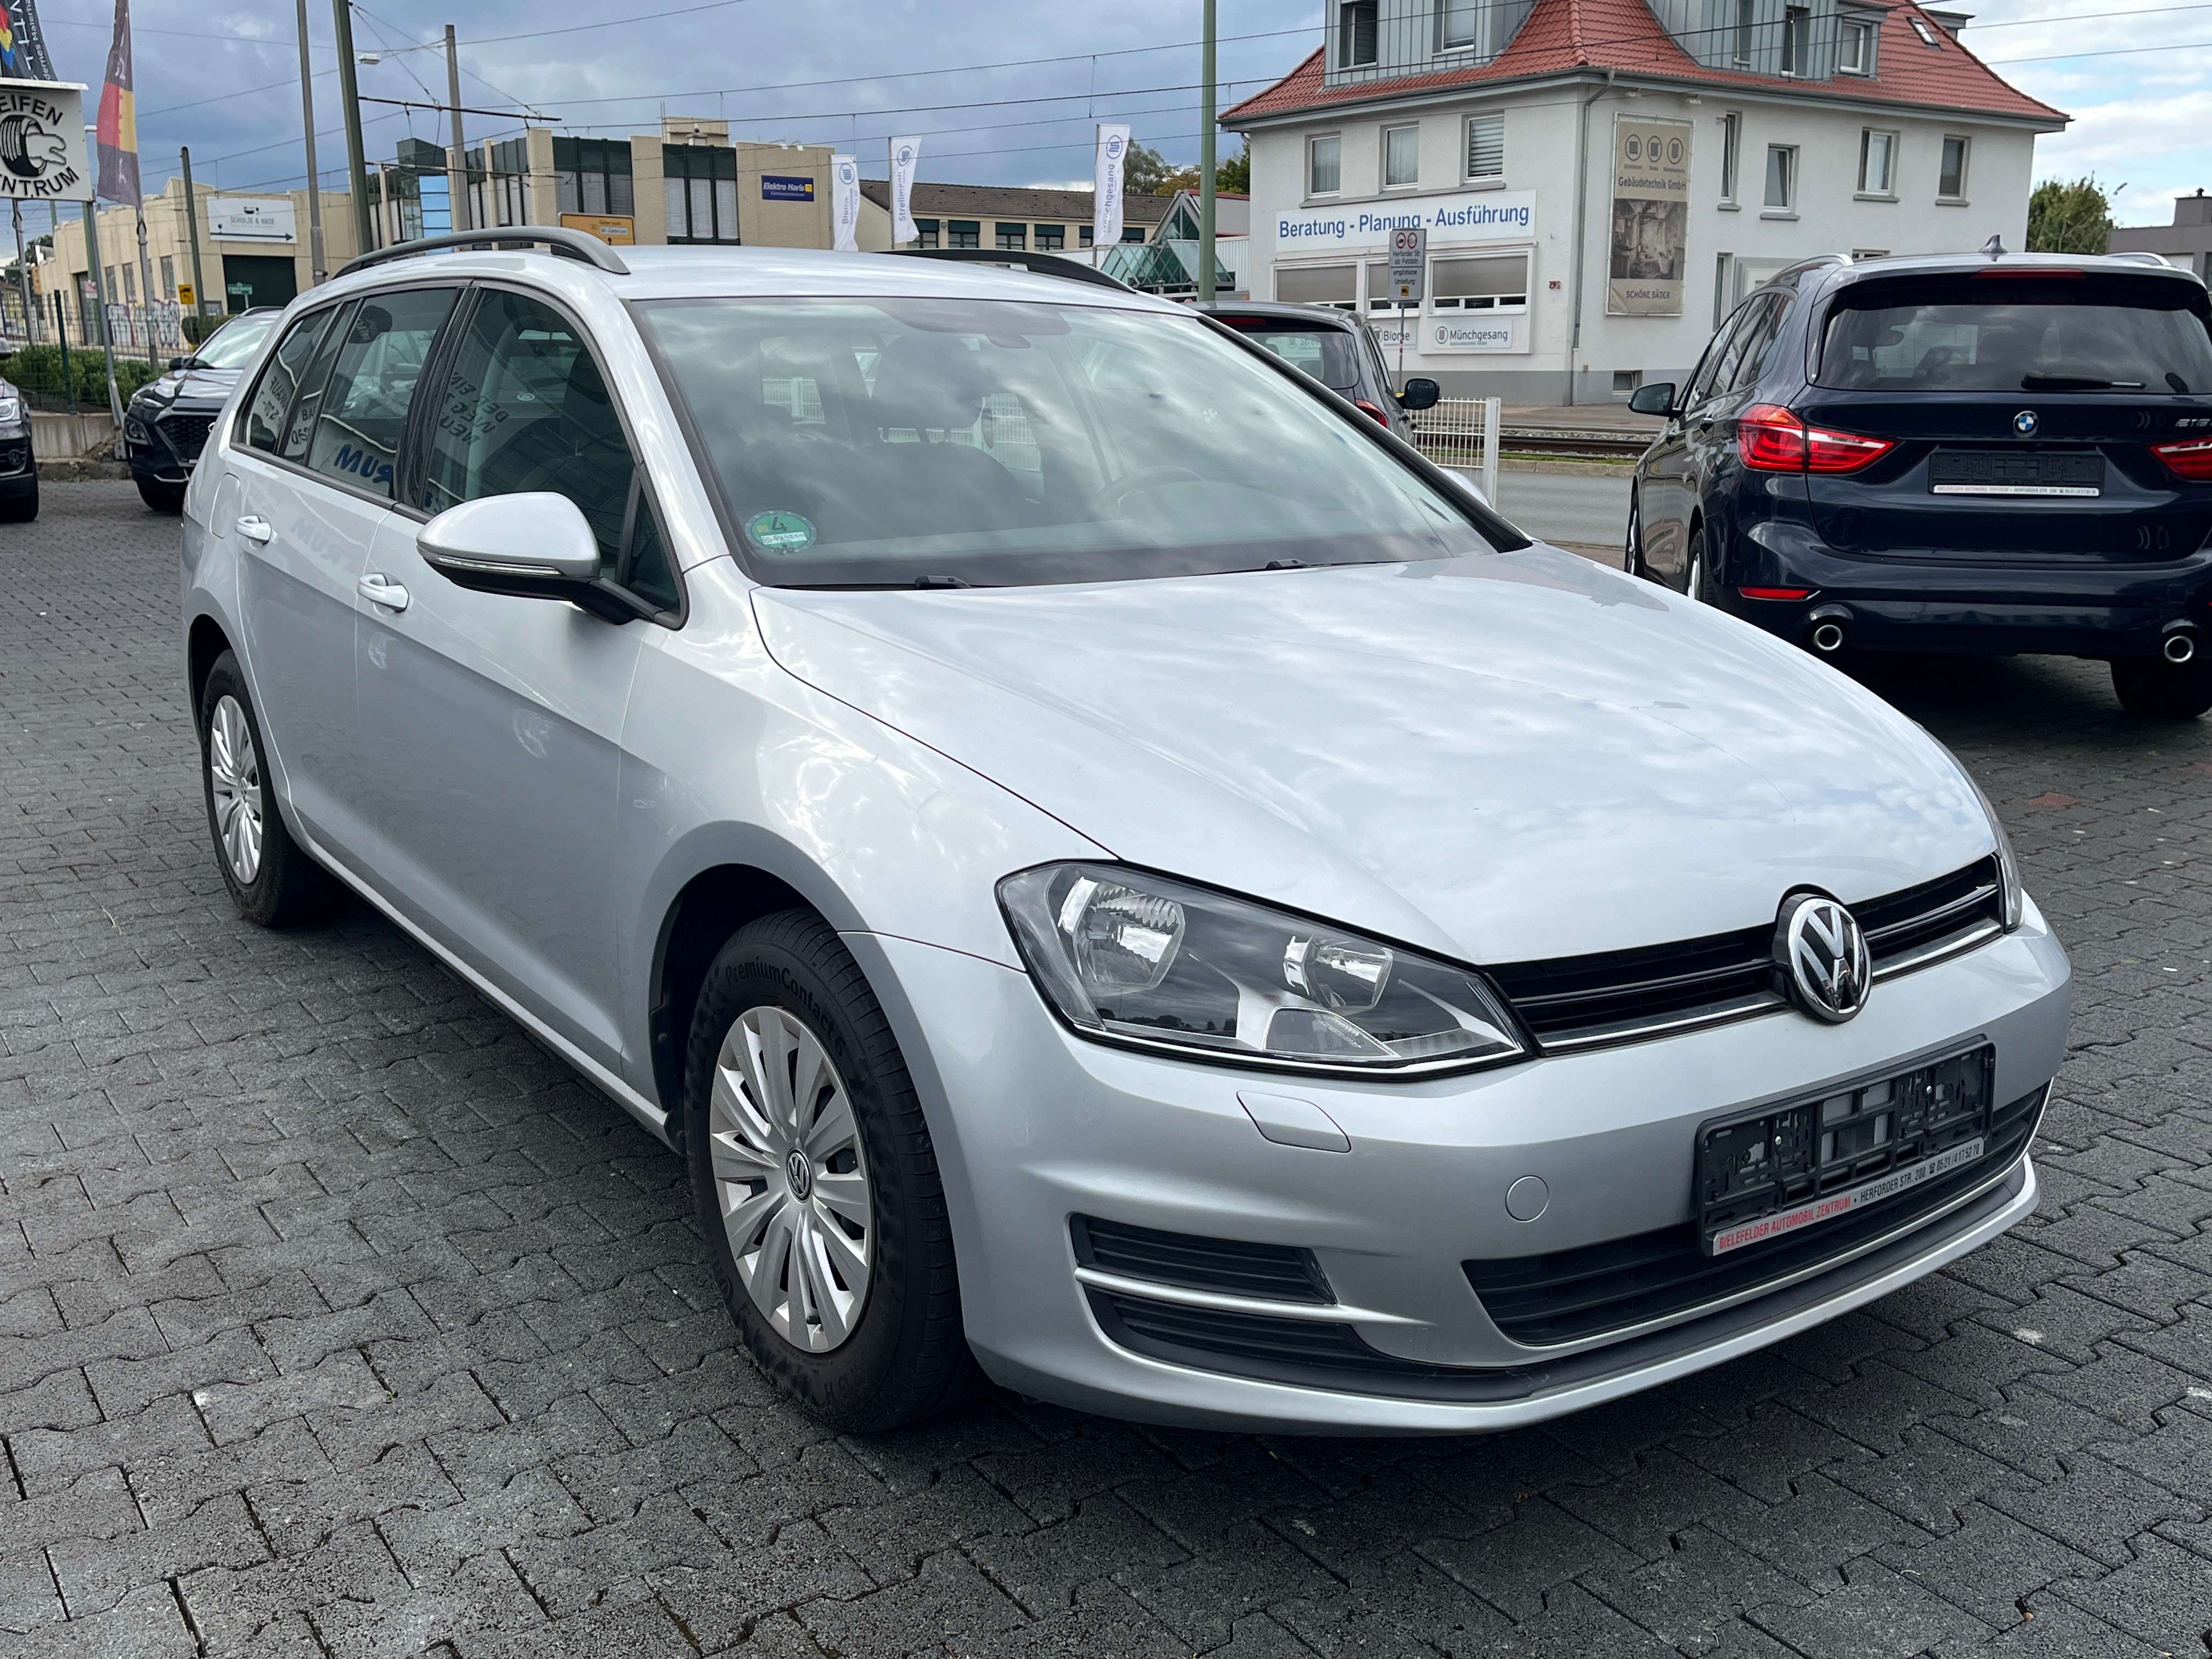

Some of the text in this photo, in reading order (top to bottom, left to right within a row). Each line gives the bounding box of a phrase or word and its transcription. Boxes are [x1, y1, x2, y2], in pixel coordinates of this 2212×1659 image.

[0, 167, 80, 196] NTRUM
[1618, 176, 1686, 191] Gebäudetechnik GmbH
[1279, 219, 1345, 238] Beratung
[1359, 213, 1421, 232] Planung
[1435, 205, 1529, 227] Ausführung
[1626, 289, 1671, 300] SCHÖNE BÄDER
[1449, 330, 1508, 342] Münchgesang
[772, 516, 788, 532] 4
[725, 956, 835, 1041] PremiumContact
[1719, 1222, 1769, 1250] BIELEFELDER
[1771, 1209, 1815, 1233] AUTOMOBIL
[1816, 1196, 1851, 1218] ZENTRUM
[1860, 1178, 1898, 1203] HERFORDER
[1900, 1173, 1914, 1187] STR.
